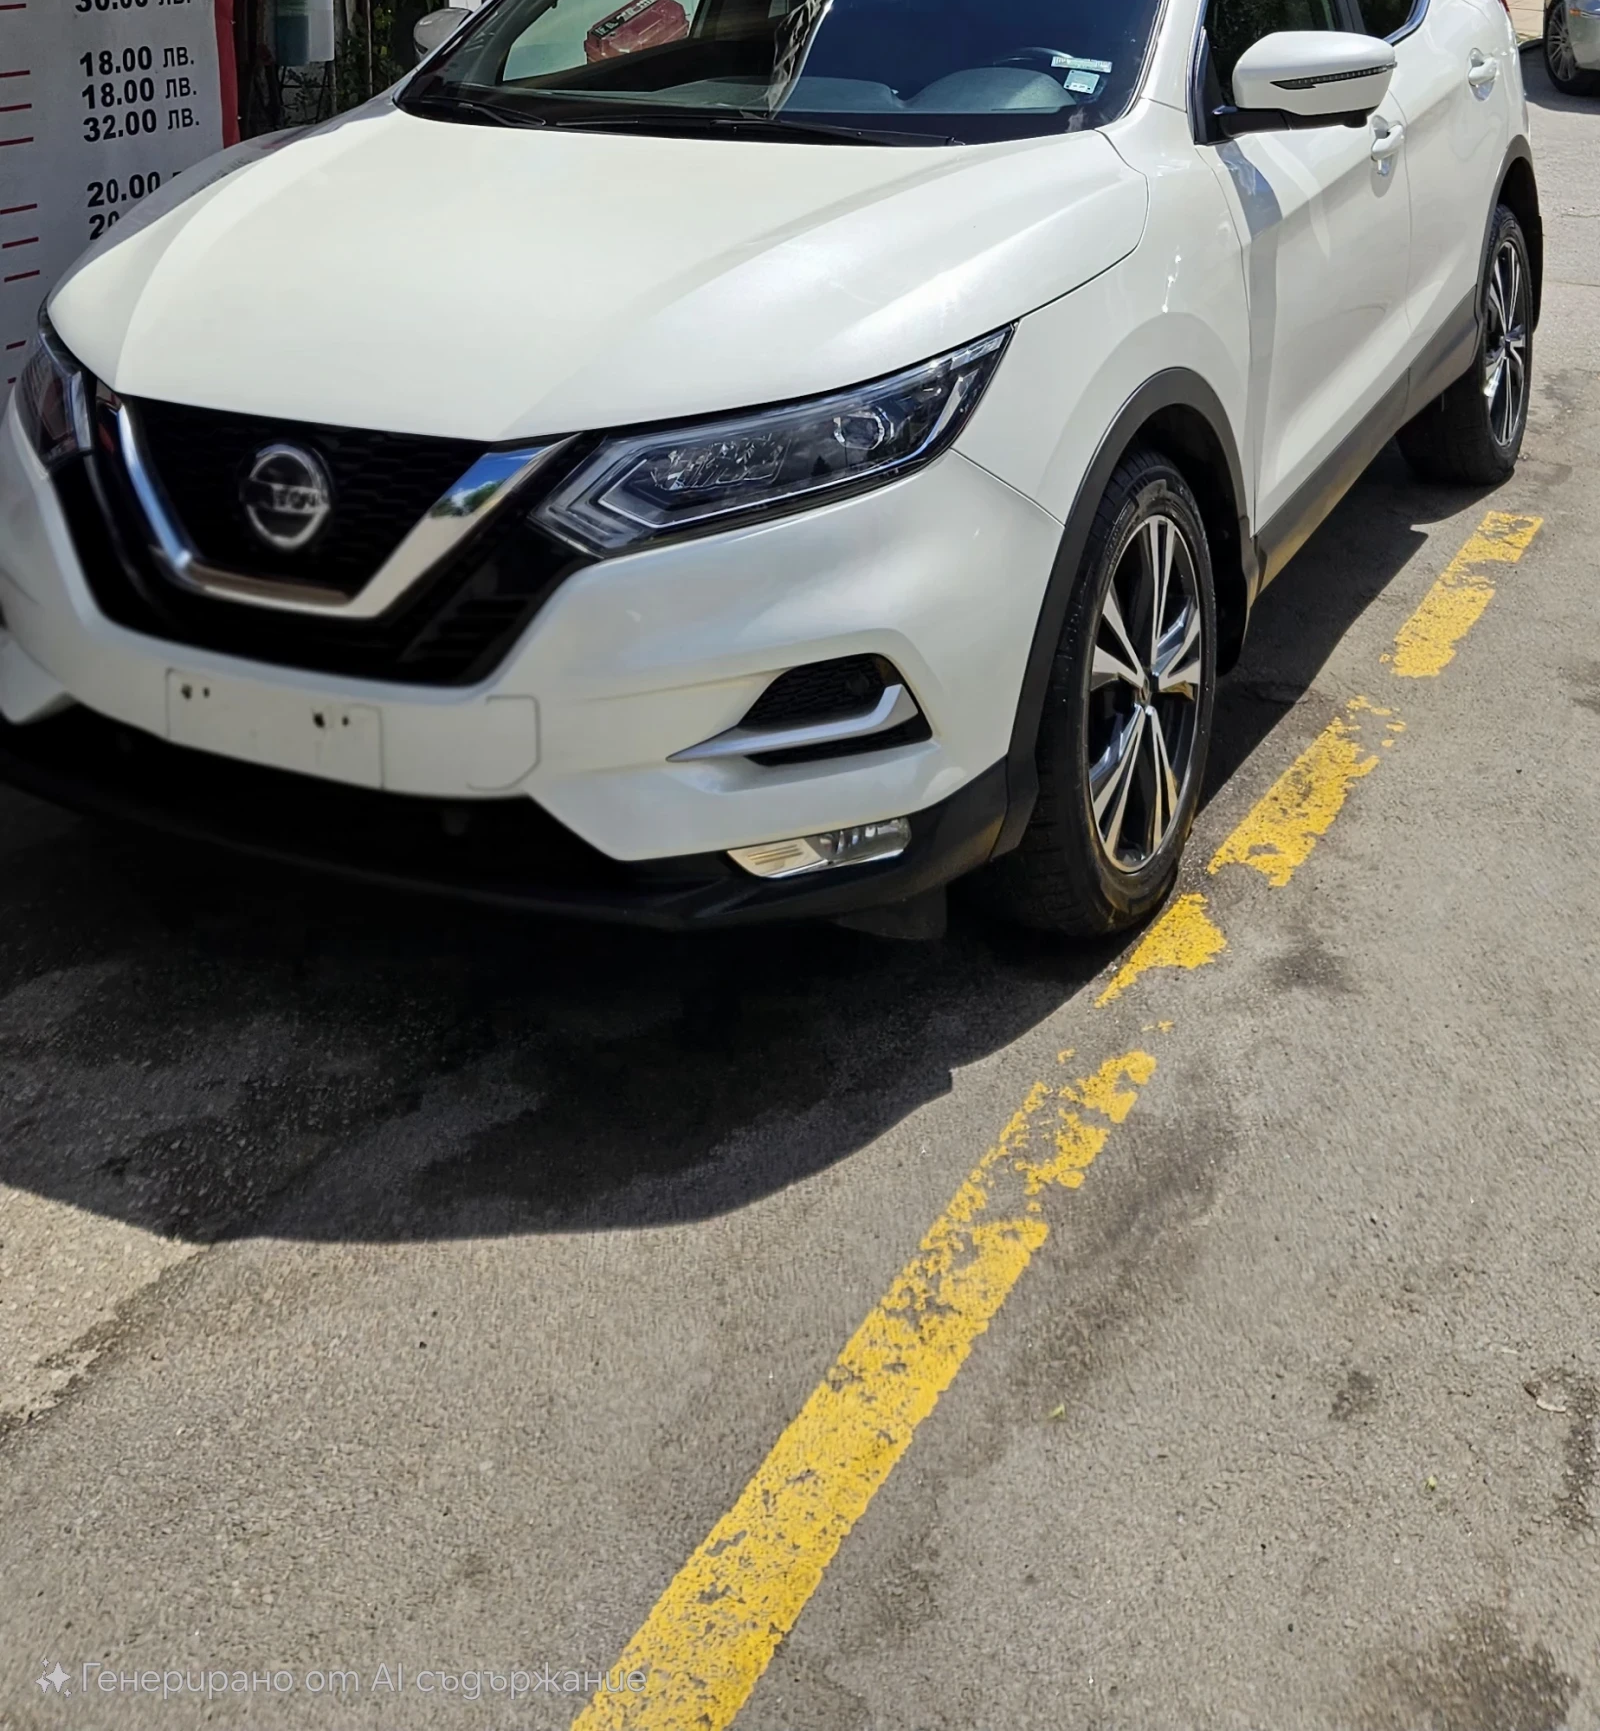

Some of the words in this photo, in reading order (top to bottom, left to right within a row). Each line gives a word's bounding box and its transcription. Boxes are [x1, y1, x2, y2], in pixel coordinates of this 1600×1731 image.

[79, 46, 153, 77] 18.00
[81, 77, 155, 110] 18.00
[82, 108, 157, 143] 32.00
[86, 171, 161, 208] 20.00
